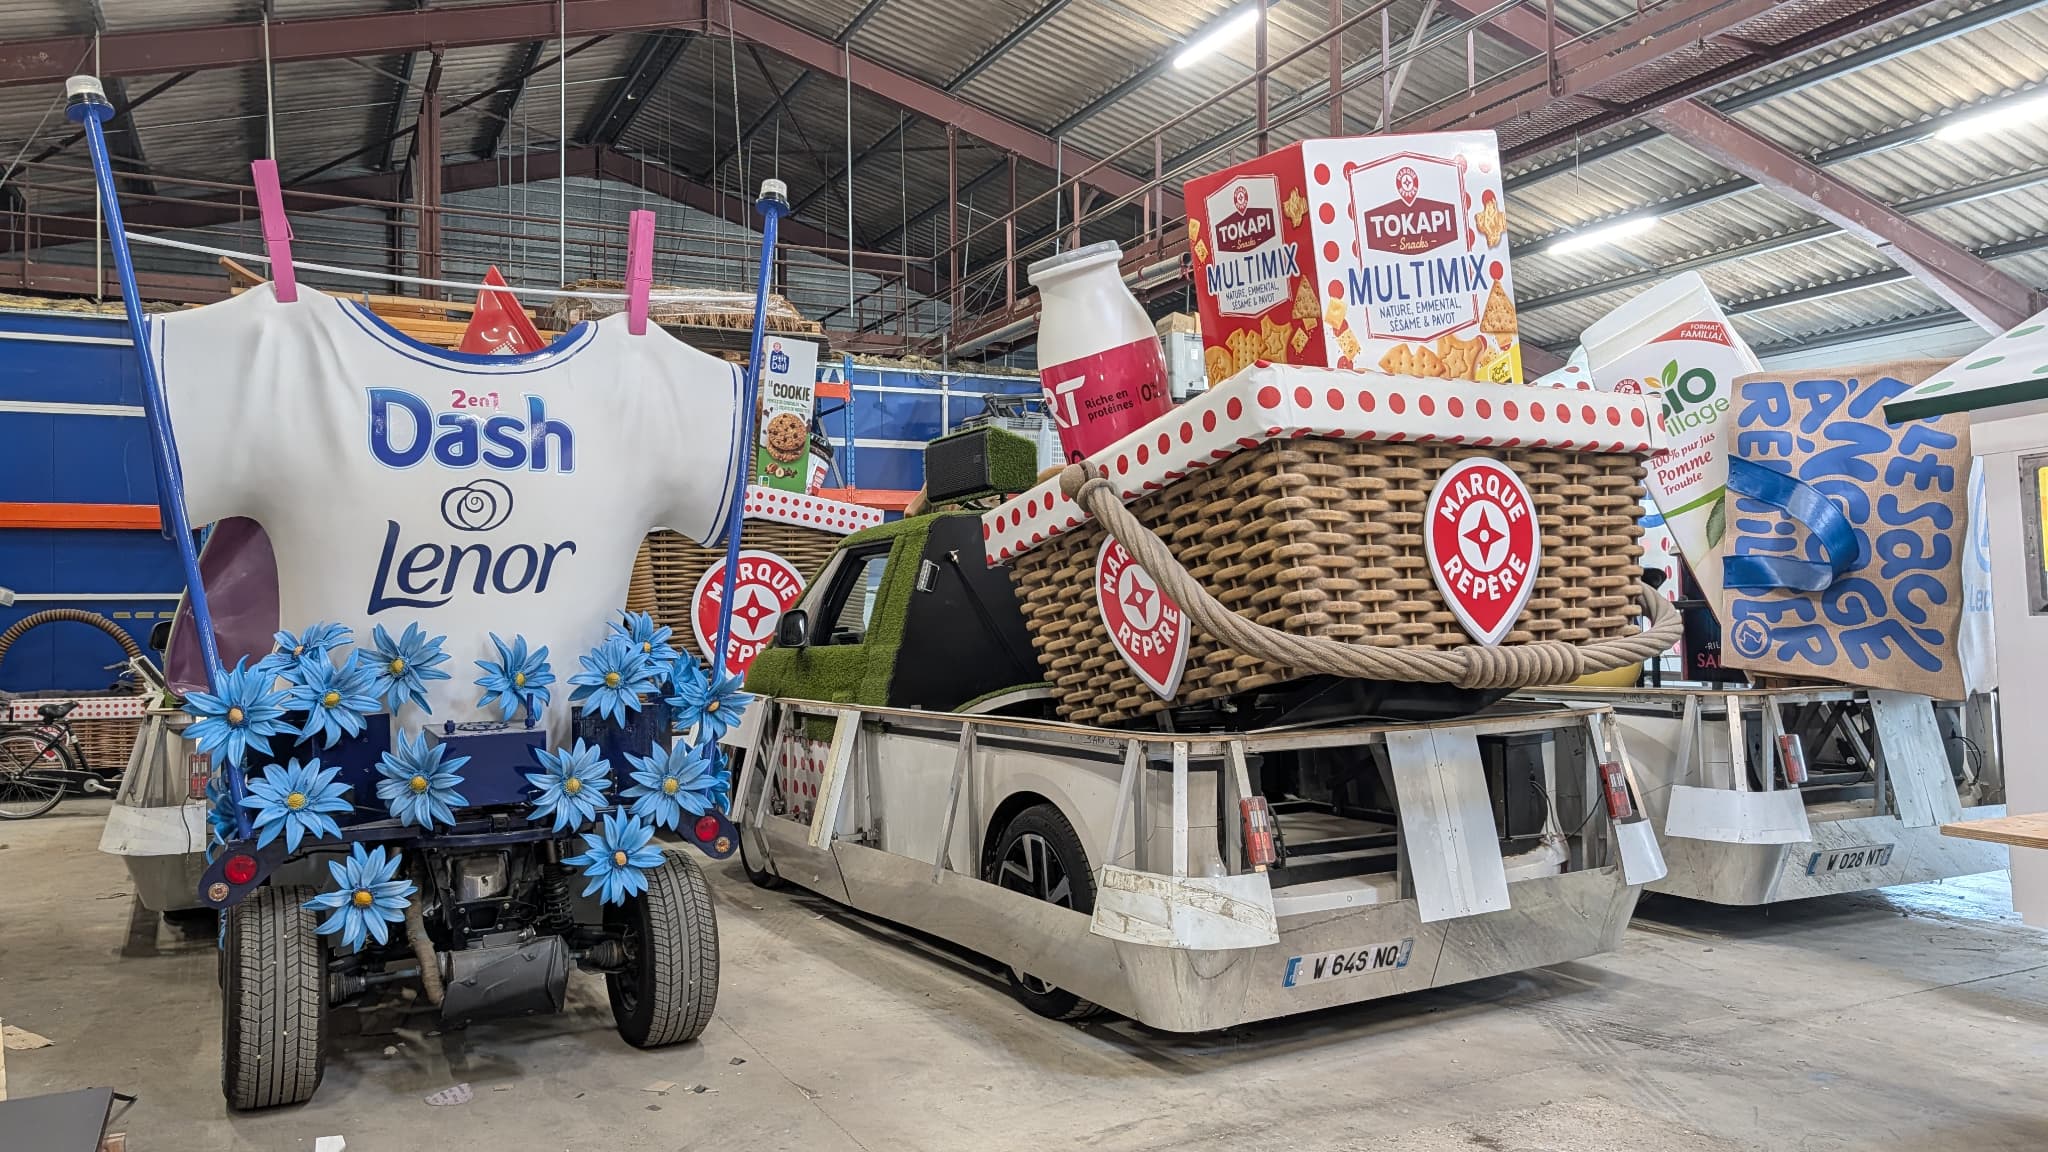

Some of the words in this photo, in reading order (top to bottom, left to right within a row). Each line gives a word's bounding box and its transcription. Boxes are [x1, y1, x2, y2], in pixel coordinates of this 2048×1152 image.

[1219, 213, 1271, 243] TOKAPI
[1370, 209, 1451, 238] TOKAPI
[1400, 236, 1429, 251] Snacks
[1207, 245, 1299, 294] MULTIMIX
[1348, 254, 1488, 306] MULTIMIX
[1226, 288, 1248, 301] NATURE,
[1380, 303, 1414, 319] NATURE,
[1416, 297, 1462, 314] EMMENTAL,
[1390, 317, 1422, 333] SÉSAME
[1424, 316, 1430, 326] &
[1432, 312, 1456, 326] PAVOT
[1680, 331, 1723, 341] FAMILIAL
[1690, 323, 1720, 331] FORMAT
[773, 383, 811, 402] COOKIE
[1084, 393, 1114, 410] Riche
[1116, 389, 1129, 400] en
[1087, 400, 1134, 423] protéines
[1664, 398, 1730, 437] illage
[365, 386, 576, 473] Dash
[1651, 448, 1680, 470] 100%
[1681, 440, 1699, 457] pur
[1700, 433, 1716, 448] jus
[1657, 451, 1713, 486] Pomme
[1440, 473, 1526, 523] MARQUE
[1663, 472, 1704, 496] Trouble
[367, 519, 577, 616] Lenor
[1443, 552, 1527, 601] REPÈRE
[706, 562, 799, 604] MRQUE
[1117, 604, 1178, 657] REPÈRE
[1826, 854, 1839, 871] W
[1839, 851, 1865, 870] 028
[1865, 848, 1884, 865] NT
[1313, 957, 1328, 979] W
